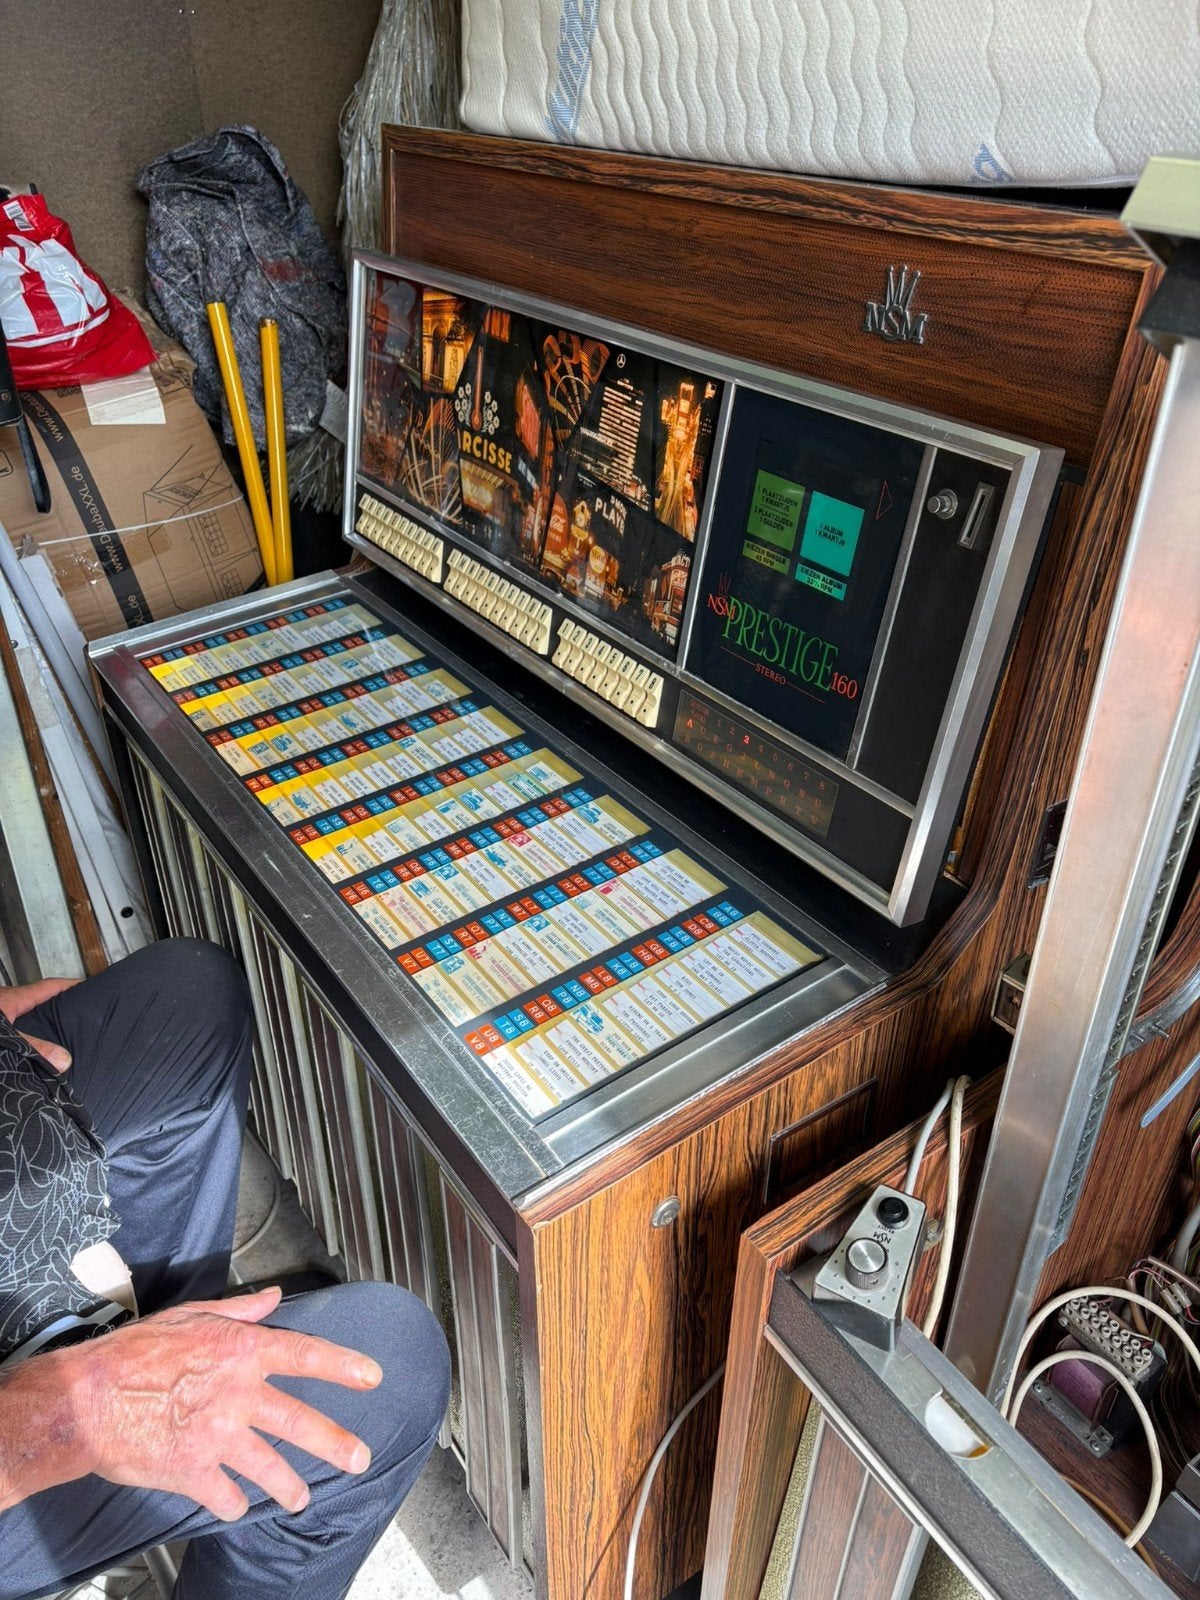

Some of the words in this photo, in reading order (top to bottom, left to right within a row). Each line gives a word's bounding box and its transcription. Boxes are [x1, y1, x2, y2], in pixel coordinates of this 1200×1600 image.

[862, 302, 928, 344] NSM
[70, 465, 124, 574] www.DeubaXXL.de
[824, 524, 844, 537] ALBUM
[818, 530, 846, 547] KWARTJE
[747, 542, 766, 556] KIEZEN
[763, 557, 775, 567] RPM
[801, 567, 820, 581] KIEZEN
[823, 575, 843, 590] ALBUM
[820, 583, 833, 593] RPM
[707, 592, 736, 620] NSM
[722, 595, 839, 692] PRESTIGE
[562, 623, 569, 634] 1
[572, 630, 581, 642] 2
[585, 637, 593, 648] 3
[597, 645, 605, 656] 4
[609, 652, 618, 665] 5
[621, 661, 630, 673] 6
[636, 669, 644, 680] 7
[648, 677, 657, 690] 8
[755, 663, 786, 686] STEREO
[830, 672, 858, 700] 160
[686, 718, 694, 728] A
[612, 860, 624, 870] D7
[563, 882, 576, 893] H7
[512, 905, 525, 916] M7
[525, 901, 538, 911] L7
[724, 906, 738, 916] A8
[499, 913, 512, 923] N7
[700, 918, 714, 929] C8
[713, 912, 727, 923] B8
[487, 919, 499, 929] P7
[688, 924, 702, 935] D8
[471, 925, 484, 936] Q7
[676, 931, 689, 942] E8
[460, 931, 472, 943] R7
[665, 937, 678, 949] F8
[444, 939, 458, 951] S7
[649, 943, 664, 955] G8
[416, 951, 430, 963] U7
[432, 946, 444, 957] T7
[637, 949, 652, 962] H8
[403, 957, 416, 968] V7
[626, 958, 638, 969] J8
[695, 962, 706, 970] THE
[598, 970, 611, 981] L8
[612, 964, 626, 976] K8
[584, 976, 599, 989] M8
[570, 984, 585, 997] N8
[557, 993, 570, 1004] P8
[541, 999, 555, 1012] Q8
[529, 1006, 541, 1019] R8
[514, 1015, 527, 1027] S8
[501, 1021, 512, 1034] T8
[484, 1029, 499, 1043] U8
[470, 1036, 485, 1050] V8
[873, 1231, 892, 1244] NSM
